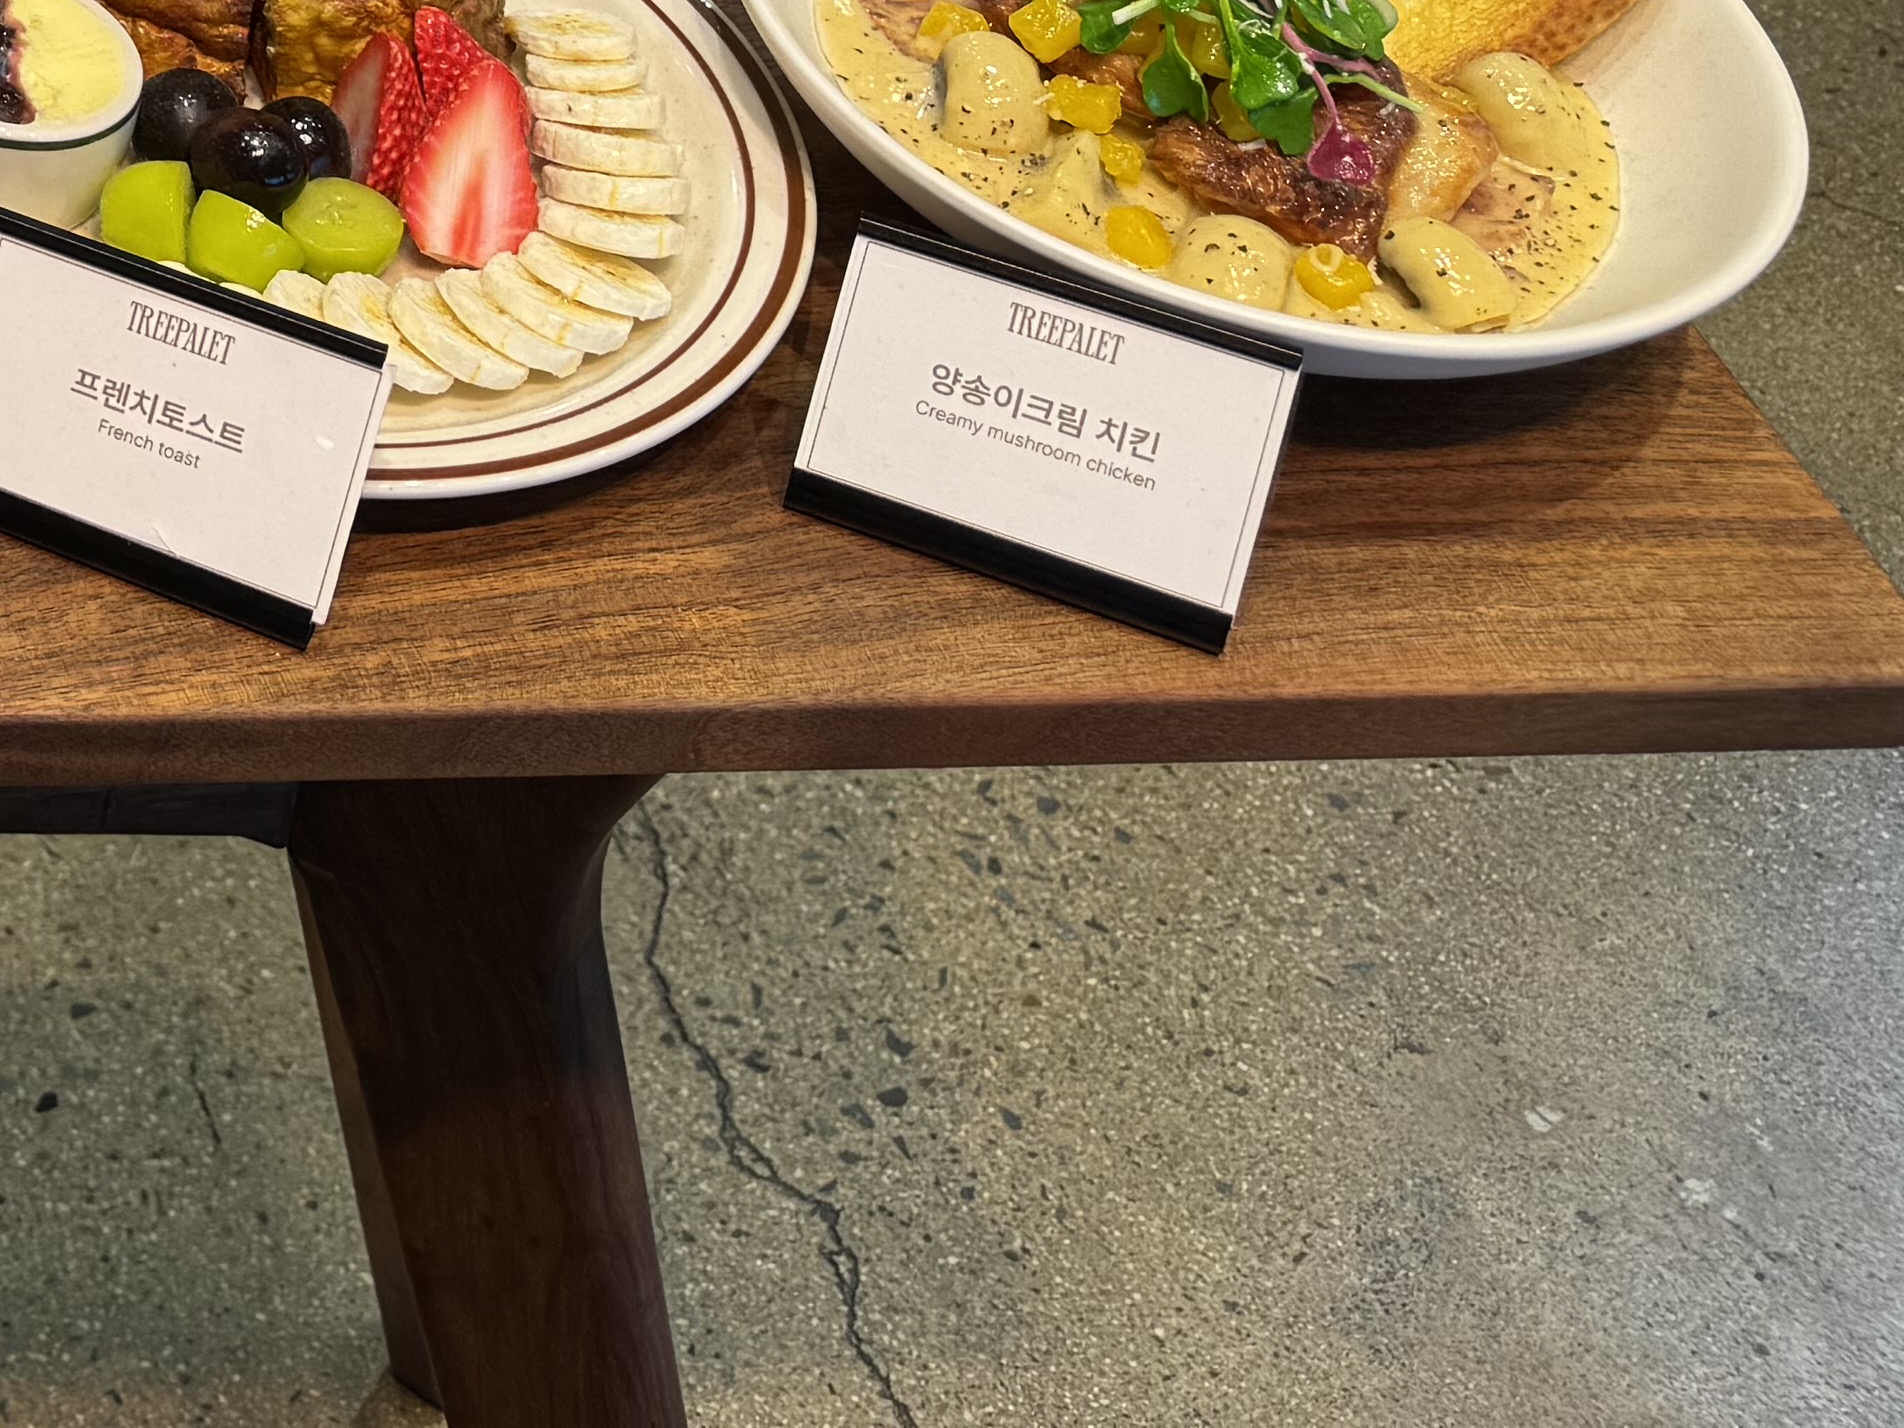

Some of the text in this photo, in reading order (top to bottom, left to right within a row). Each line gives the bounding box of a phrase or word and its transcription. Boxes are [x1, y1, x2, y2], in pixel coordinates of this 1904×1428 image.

[126, 301, 235, 366] TREEPALET
[1007, 302, 1125, 365] TREEPALET
[70, 369, 245, 453] 프렌치토스트
[98, 419, 201, 469] French toast
[915, 399, 1157, 491] Creamy mushroom chicken
[930, 363, 1161, 463] 양송이크림 치킨
